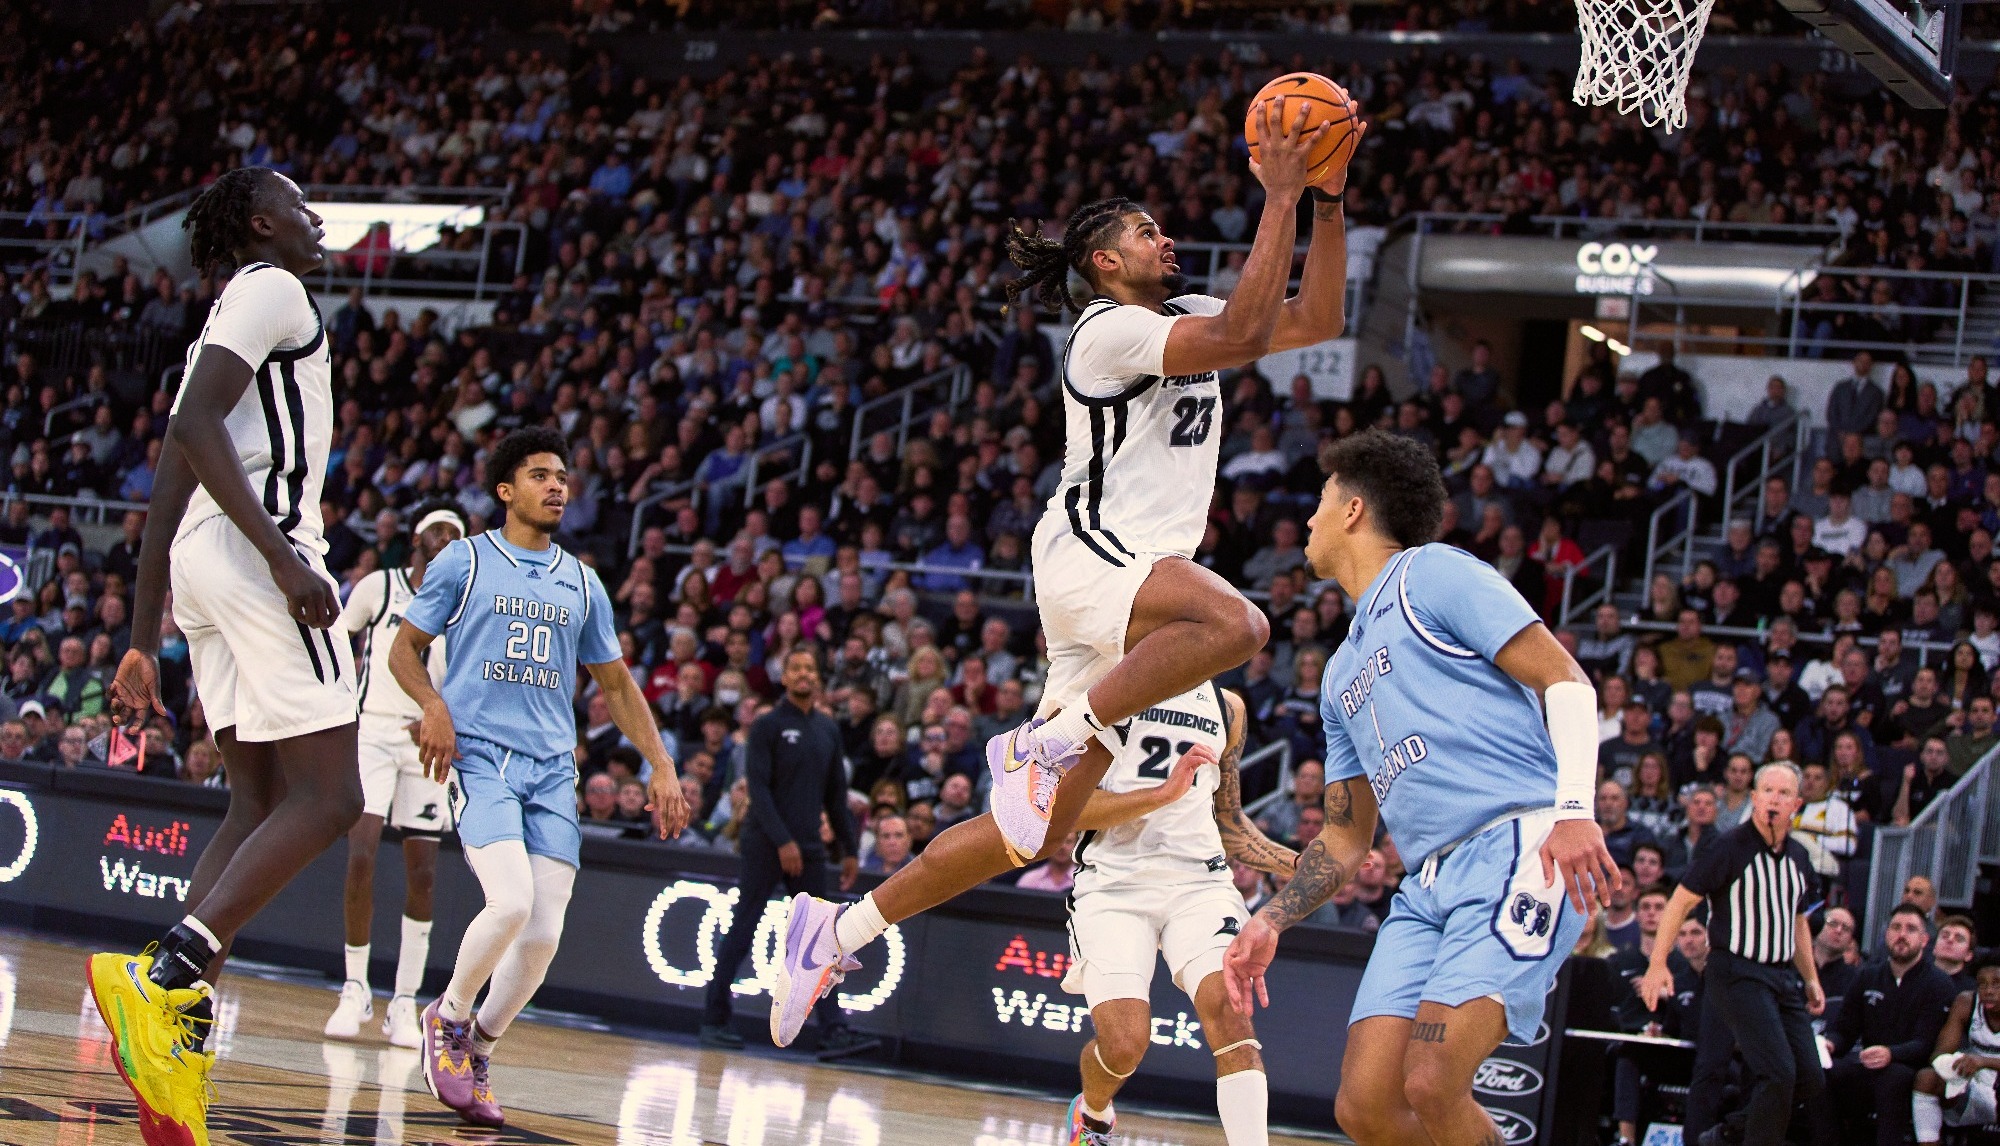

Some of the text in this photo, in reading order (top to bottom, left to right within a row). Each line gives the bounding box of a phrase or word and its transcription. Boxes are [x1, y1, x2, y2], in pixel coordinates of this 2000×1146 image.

[1577, 242, 1658, 275] COX
[1300, 351, 1341, 375] 122
[1169, 396, 1217, 447] 23
[495, 594, 570, 627] RHODE
[506, 620, 552, 664] 20
[483, 661, 560, 689] ISLAND
[1340, 646, 1392, 719] RHODE
[1134, 708, 1219, 737] ROVIDENCE
[1370, 734, 1428, 807] ISLAND
[103, 814, 190, 857] Audi
[995, 934, 1073, 978] Au
[992, 987, 1202, 1049] Warck
[1474, 1063, 1527, 1091] Ford
